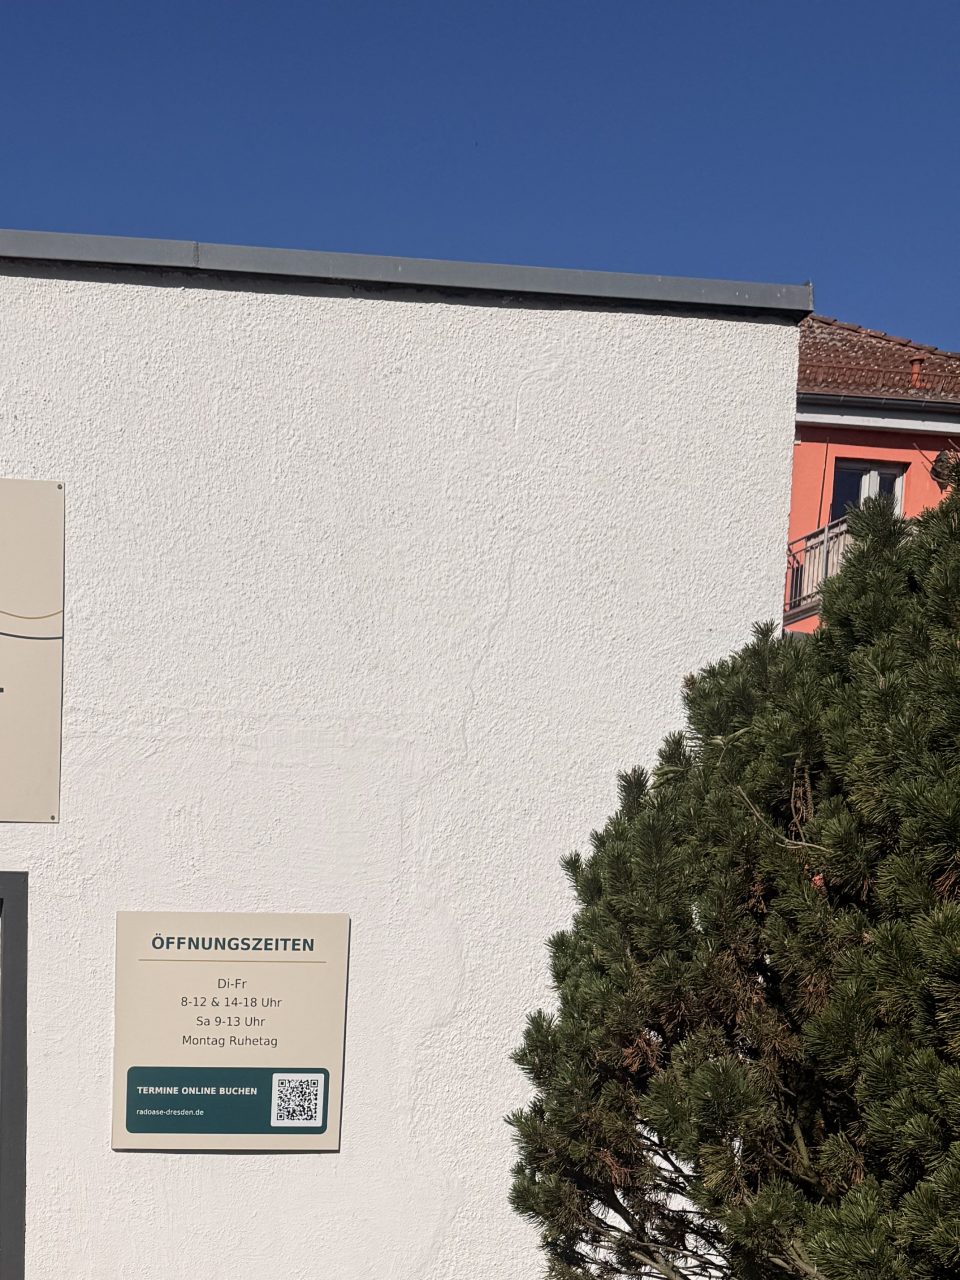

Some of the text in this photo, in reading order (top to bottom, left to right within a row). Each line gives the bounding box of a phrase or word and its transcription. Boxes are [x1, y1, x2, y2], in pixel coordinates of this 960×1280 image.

[152, 933, 314, 951] ÖFFNUNGSZEITEN
[218, 978, 247, 988] Di-Fr
[181, 997, 282, 1007] 8-12 & 14-18 Uhr
[197, 1016, 265, 1026] Sa 9-13 Uhr
[183, 1036, 277, 1048] Montag Ruhetag
[219, 1087, 257, 1095] BUCHEN
